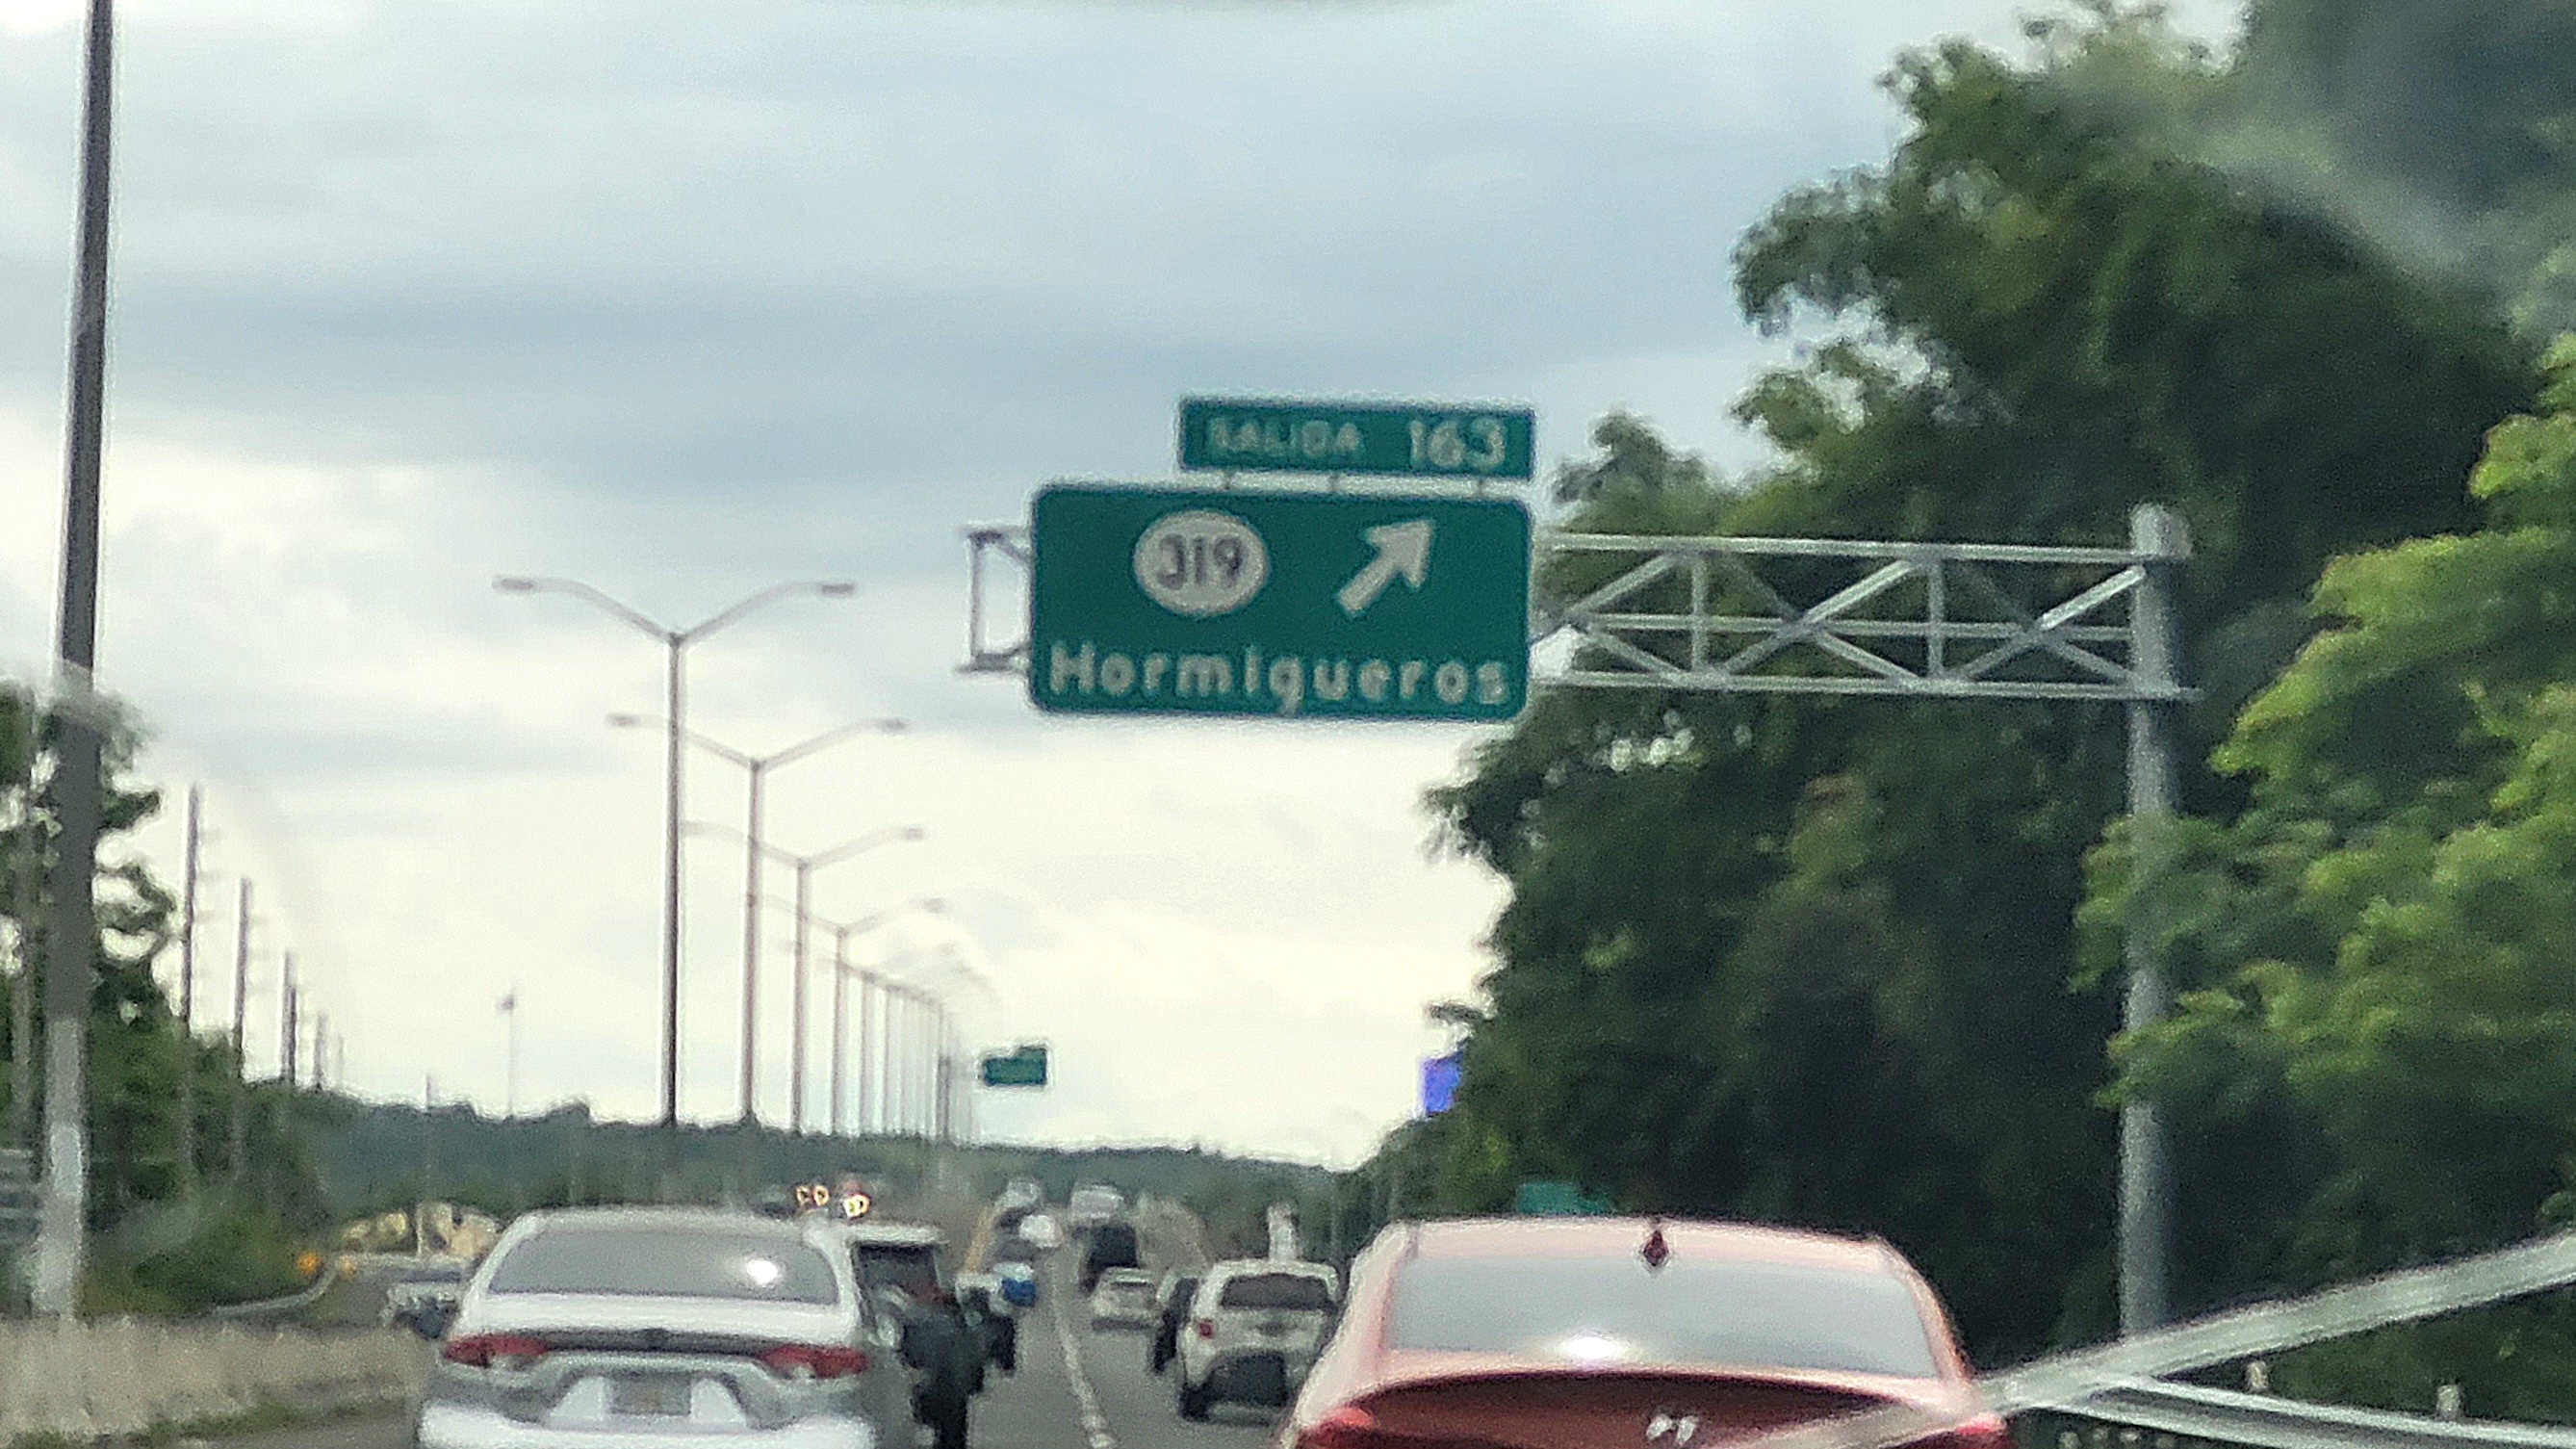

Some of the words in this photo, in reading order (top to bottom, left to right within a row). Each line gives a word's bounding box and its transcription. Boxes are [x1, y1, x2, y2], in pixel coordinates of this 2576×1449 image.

[1206, 415, 1364, 457] SALIDA
[1410, 417, 1507, 470] 163
[1157, 532, 1244, 591] 319
[1049, 639, 1508, 715] Hormigueros
